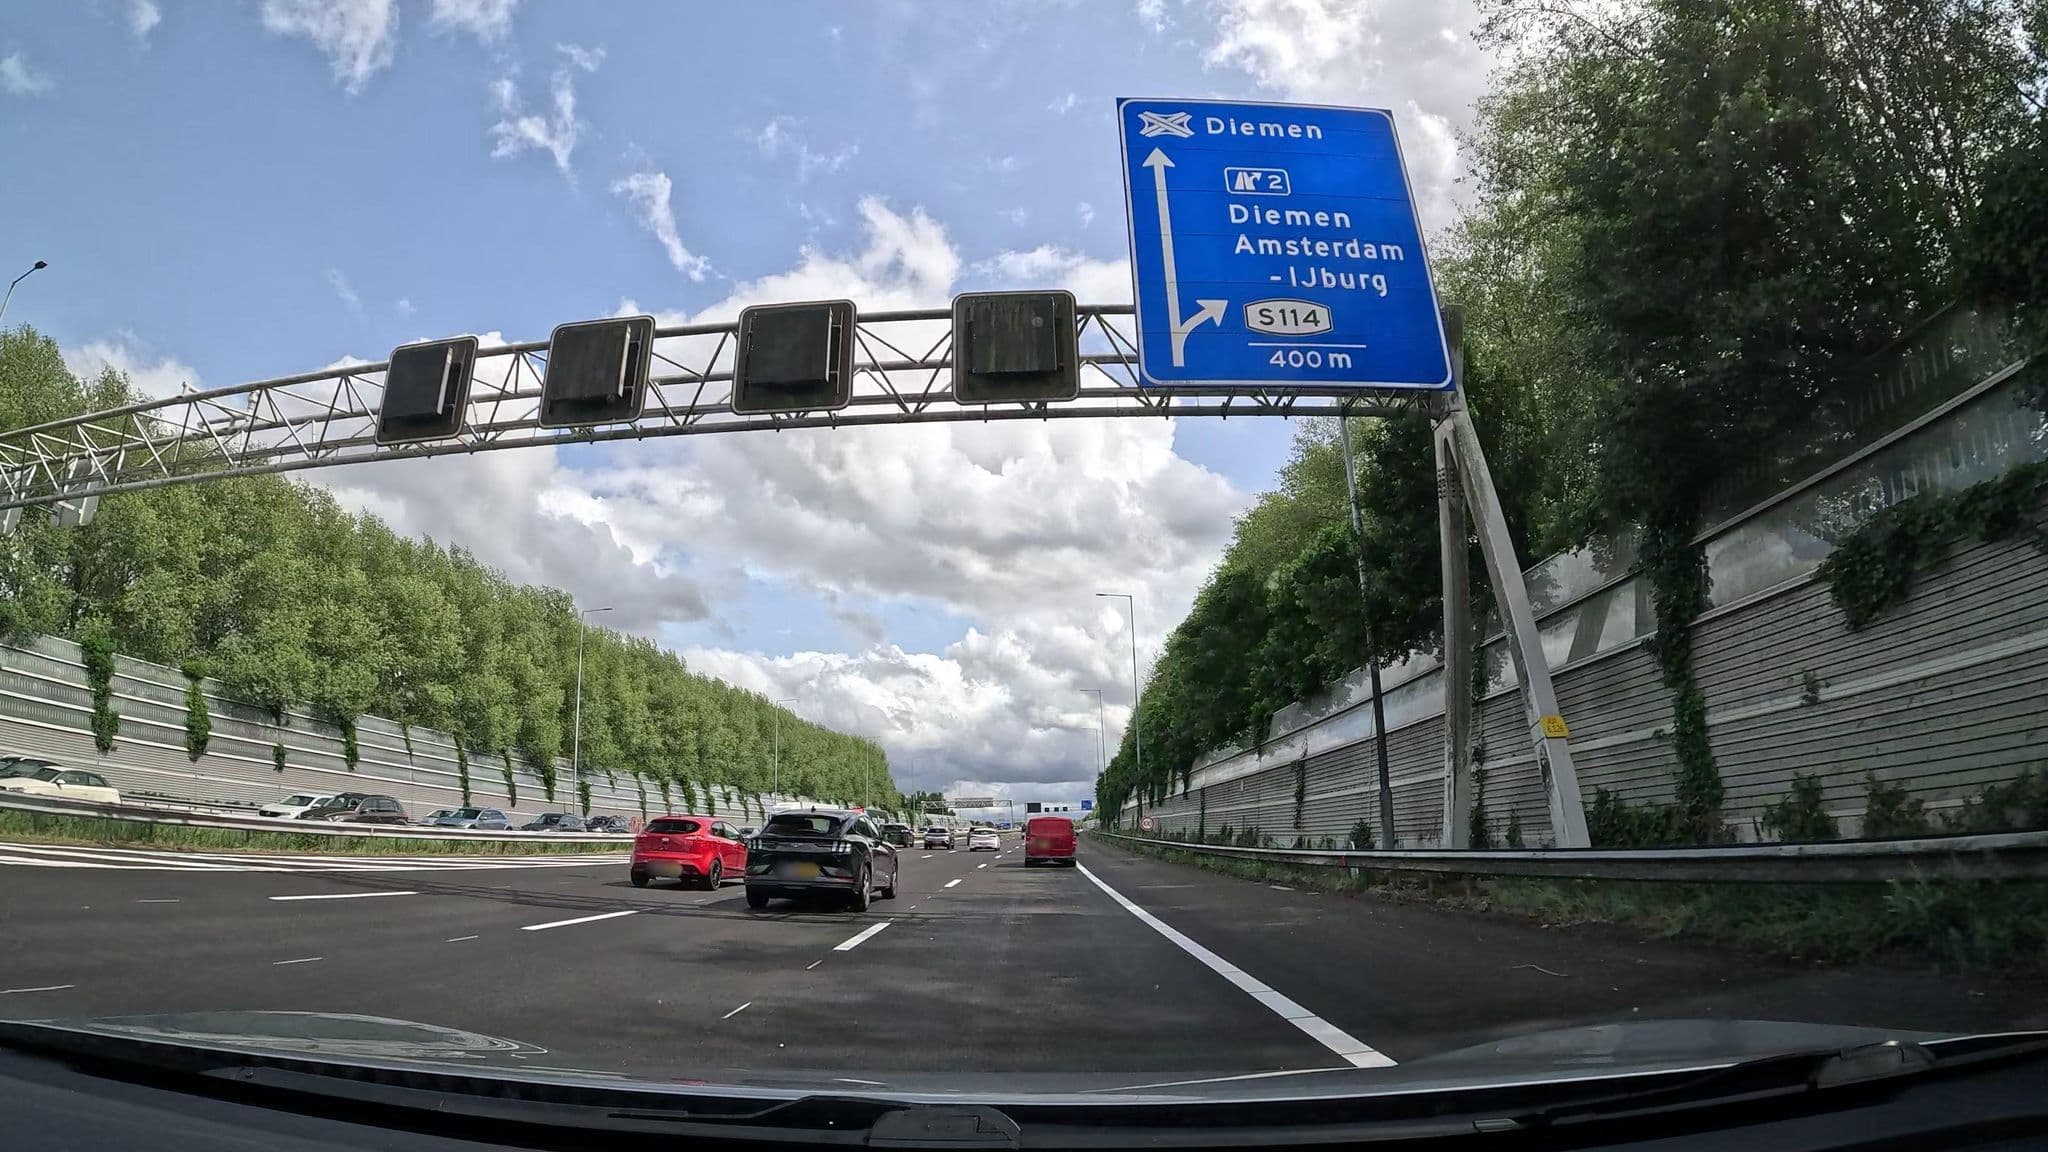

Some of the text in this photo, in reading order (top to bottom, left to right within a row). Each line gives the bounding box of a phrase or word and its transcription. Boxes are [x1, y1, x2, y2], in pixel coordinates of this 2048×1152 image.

[1206, 117, 1322, 139] Diemen
[1268, 174, 1283, 189] 2
[1229, 204, 1351, 228] Diemen
[1235, 234, 1404, 261] Amsterdam
[1270, 266, 1388, 297] -IJburg
[1258, 308, 1321, 327] S114
[1269, 350, 1352, 368] 400 m
